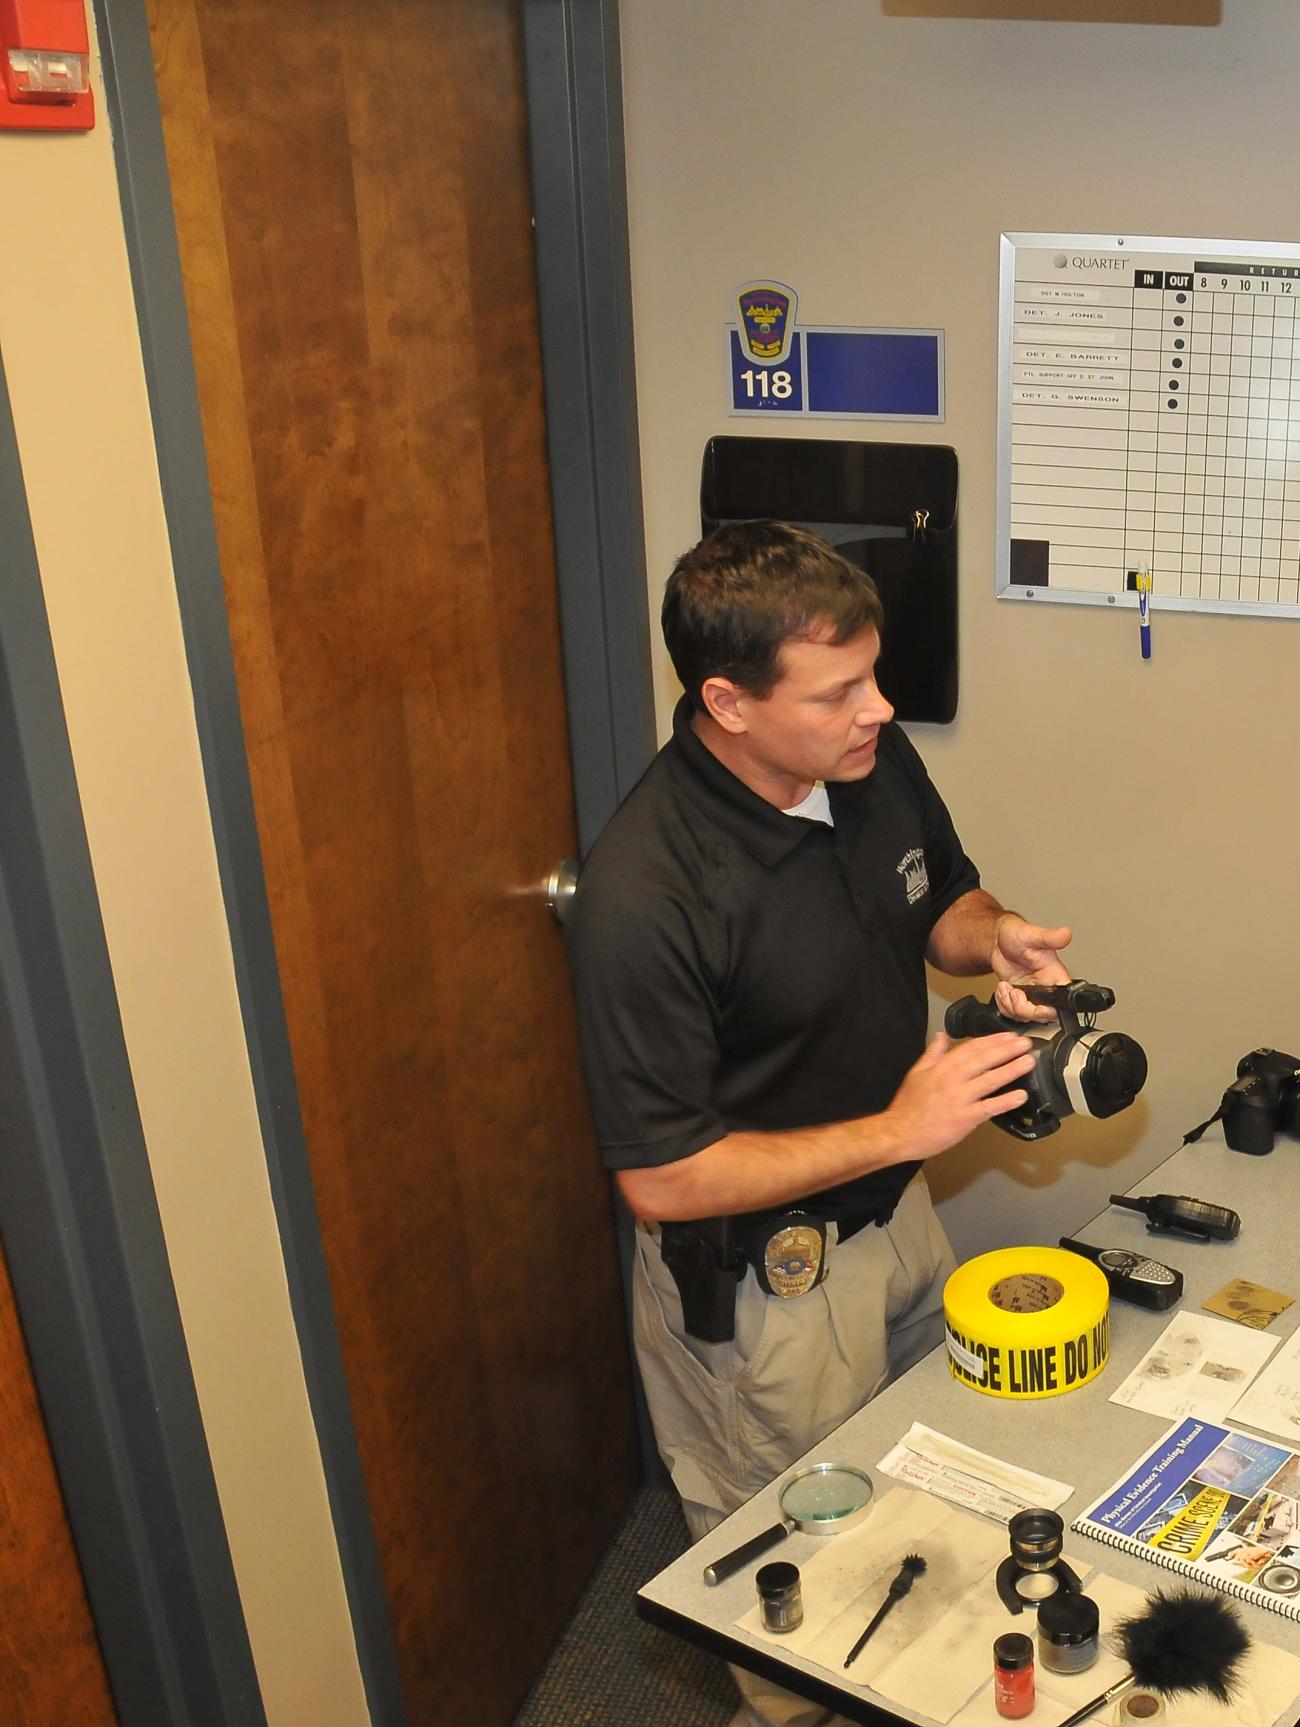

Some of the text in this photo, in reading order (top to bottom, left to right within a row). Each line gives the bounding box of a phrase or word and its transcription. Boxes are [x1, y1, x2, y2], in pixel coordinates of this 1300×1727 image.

[1072, 256, 1129, 270] QUARTET
[1143, 273, 1189, 287] IN OUT
[1200, 277, 1207, 288] 8
[1221, 278, 1228, 290] 9
[1240, 280, 1251, 291] 10
[1260, 281, 1270, 292] 11
[1281, 282, 1292, 294] 12
[1069, 312, 1103, 320] JONES
[741, 370, 792, 398] 118
[1067, 395, 1119, 403] SWENSON
[1008, 1346, 1058, 1393] LINE
[1064, 1334, 1088, 1385] DO
[1101, 1498, 1132, 1523] Physical
[1127, 1471, 1158, 1499] Evidence
[1152, 1443, 1185, 1473] Training
[1177, 1424, 1204, 1447] Manual
[1157, 1516, 1209, 1554] CRIME
[1189, 1496, 1222, 1518] SCENE
